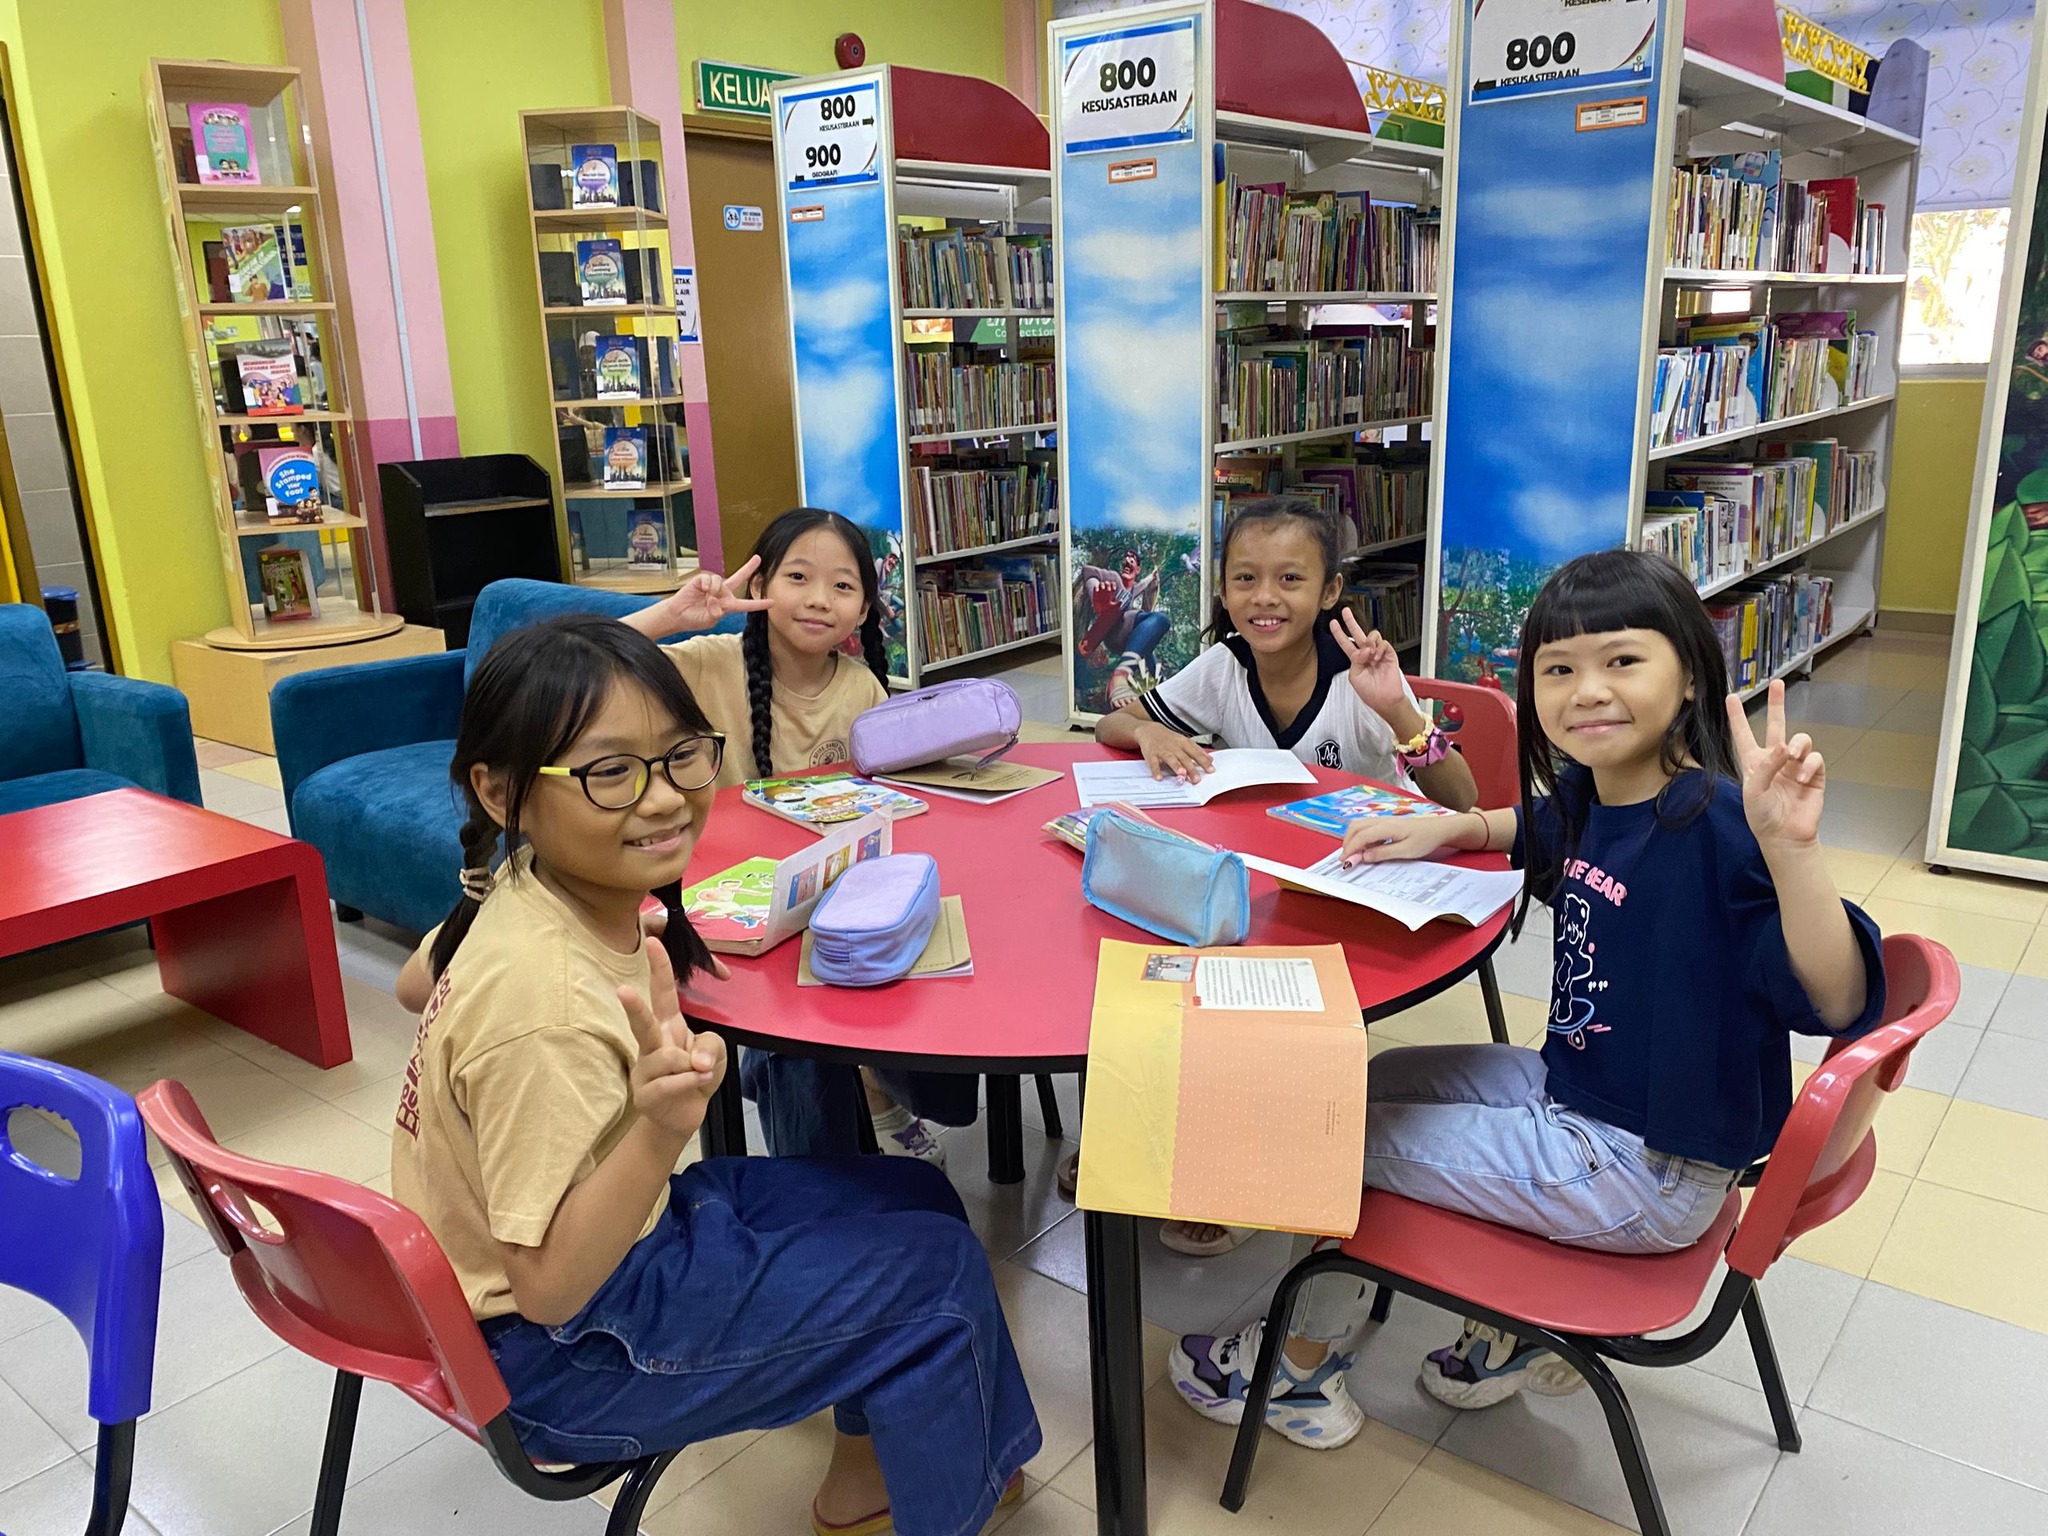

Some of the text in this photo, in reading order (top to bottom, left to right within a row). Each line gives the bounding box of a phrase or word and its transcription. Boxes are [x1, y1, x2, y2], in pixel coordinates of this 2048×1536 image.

[1506, 31, 1576, 71] 800
[1099, 57, 1156, 92] 800
[1500, 68, 1580, 87] KESUSASTERAAN
[709, 70, 773, 108] KELUA
[1081, 89, 1178, 113] KESUSASTERAAN
[820, 94, 856, 121] 800
[805, 143, 841, 168] 900
[995, 327, 1055, 338] Coection
[275, 473, 312, 489] Stamped
[279, 468, 295, 478] She
[284, 487, 304, 497] Foot
[1584, 866, 1628, 907] BEAR
